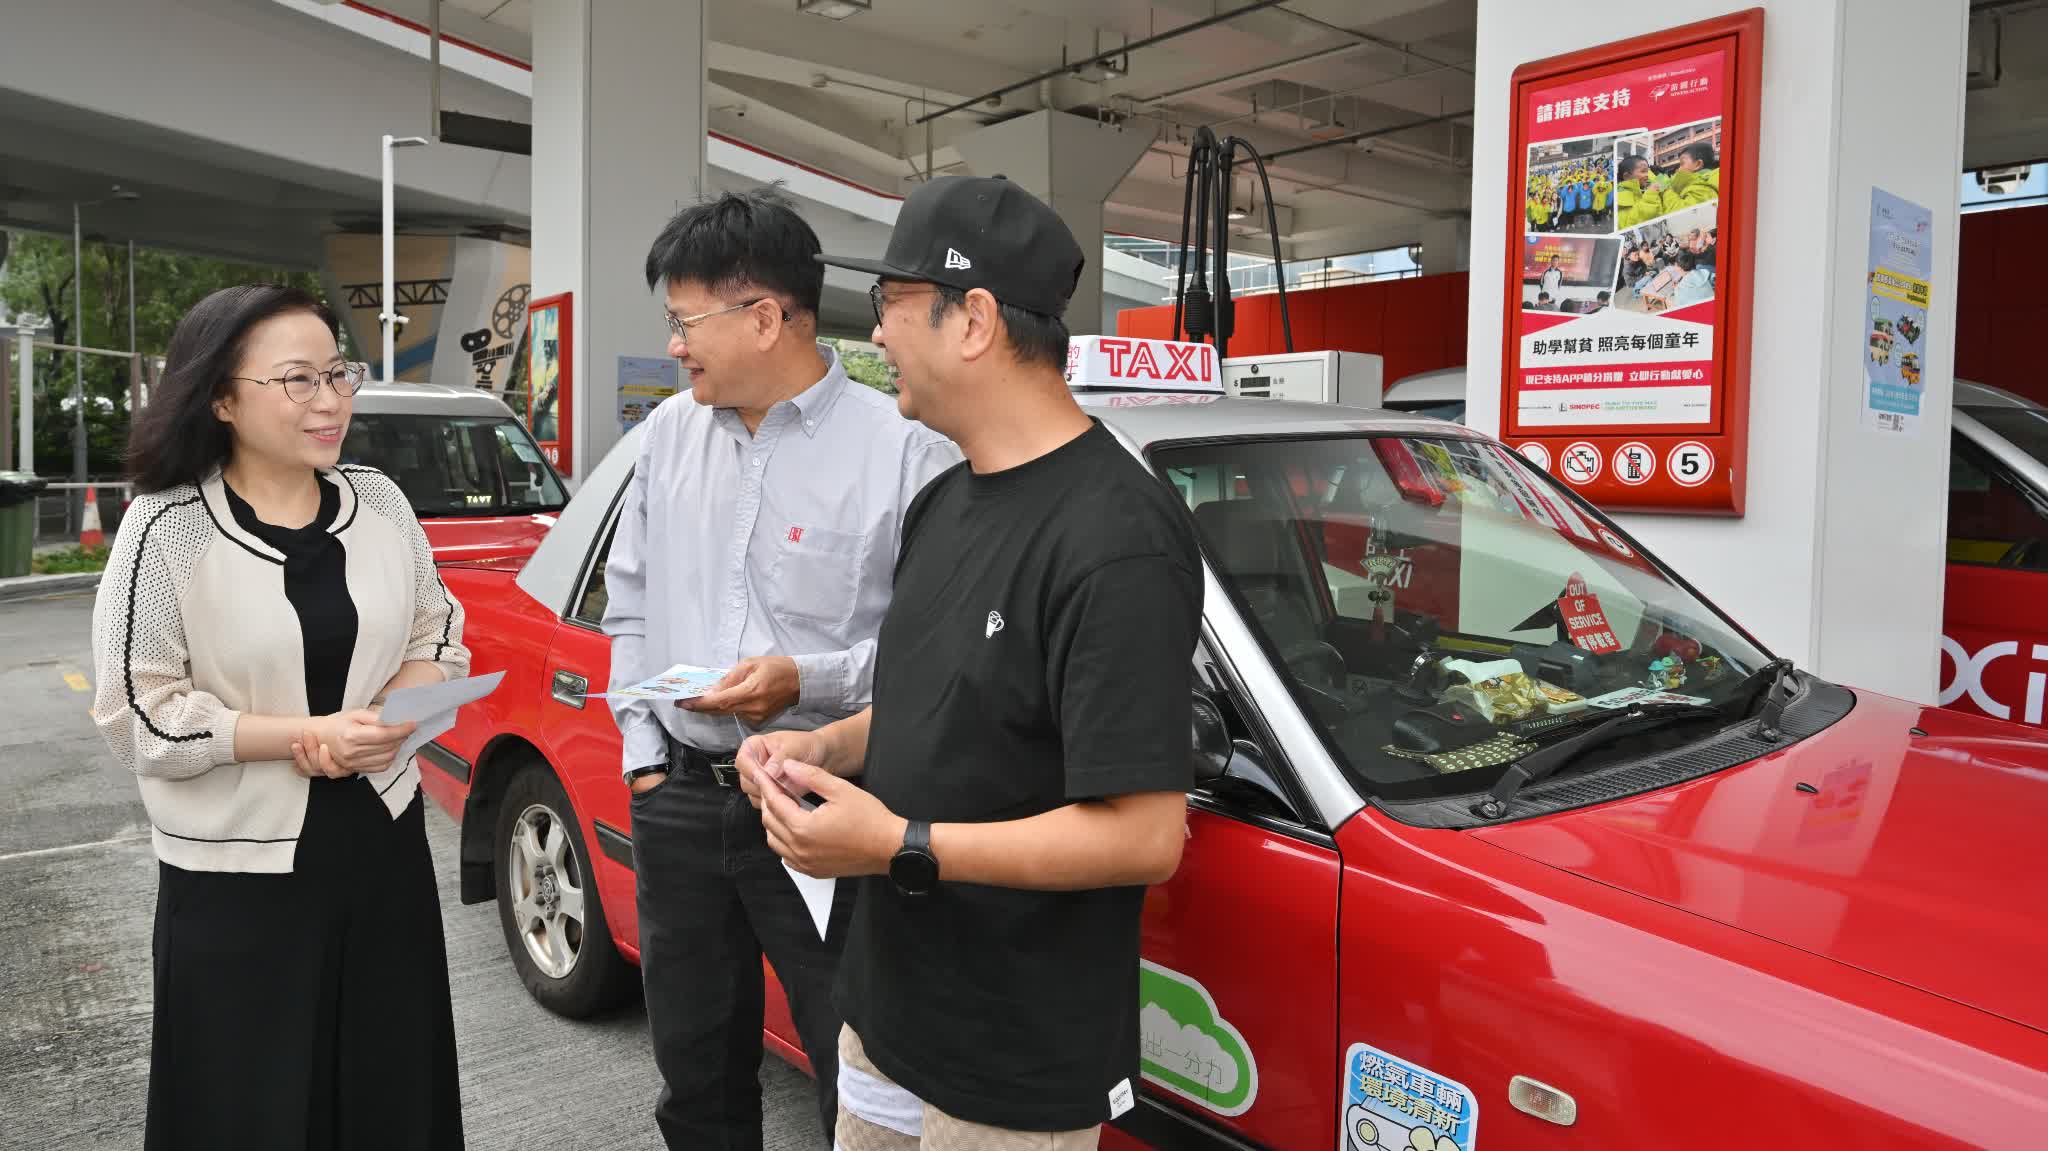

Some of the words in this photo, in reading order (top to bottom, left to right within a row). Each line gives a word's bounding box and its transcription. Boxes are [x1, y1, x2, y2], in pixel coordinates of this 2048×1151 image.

[1536, 88, 1632, 124] 請捐款支持
[1598, 331, 1699, 353] 照亮每個童年
[1100, 339, 1212, 382] TAXI
[1569, 403, 1601, 411] SINOPEC
[1681, 453, 1699, 475] 5
[1569, 584, 1585, 597] OUT
[1574, 599, 1586, 612] OF
[1568, 612, 1605, 630] SERVICE
[1140, 1031, 1223, 1086] 出一分力
[1360, 1051, 1464, 1113] 燃氣車輛
[1360, 1073, 1460, 1136] 環境清新
